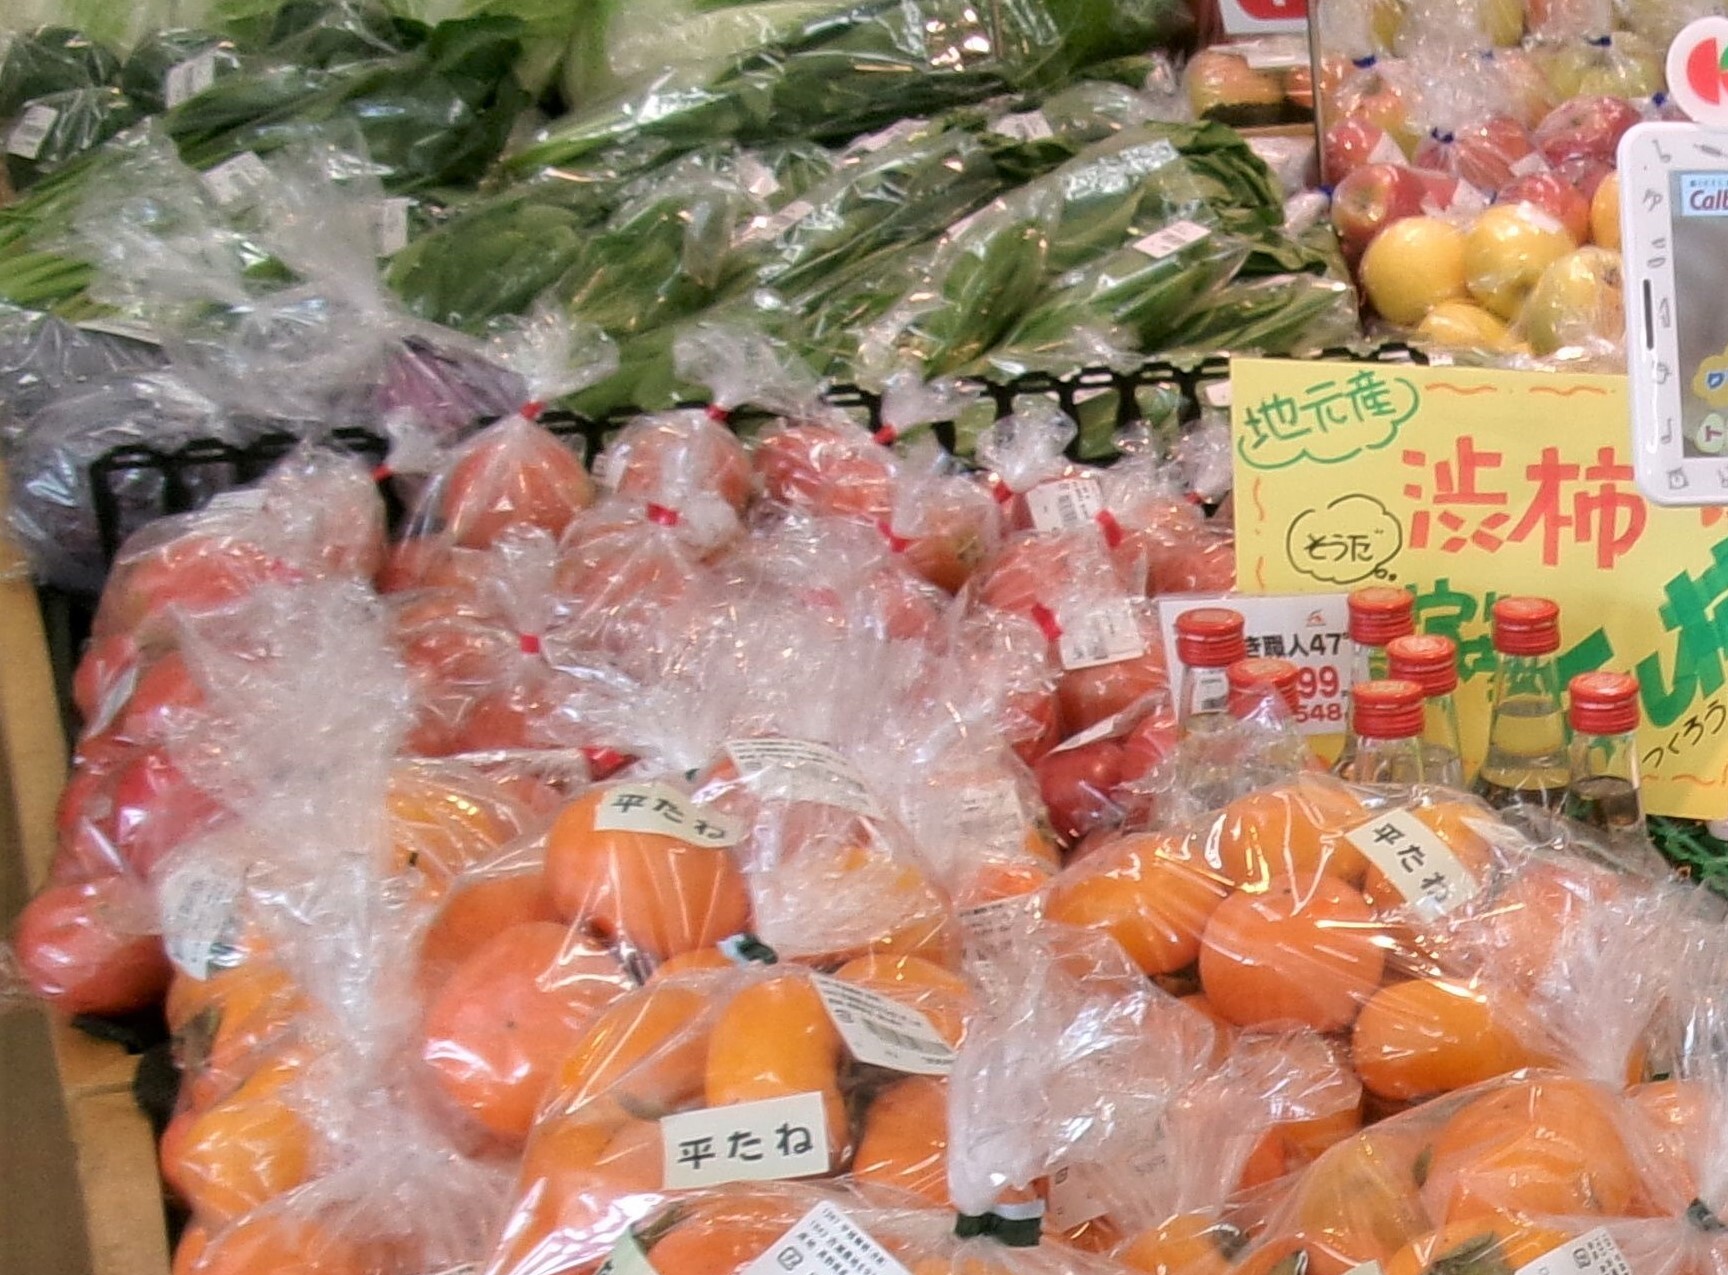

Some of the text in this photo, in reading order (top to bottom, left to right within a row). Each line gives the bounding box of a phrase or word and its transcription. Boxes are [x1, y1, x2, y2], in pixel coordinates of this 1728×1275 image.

[1243, 370, 1396, 449] 地元産
[612, 793, 726, 839] 平たね
[1372, 822, 1449, 902] 平たね
[677, 1123, 813, 1169] 平たね
